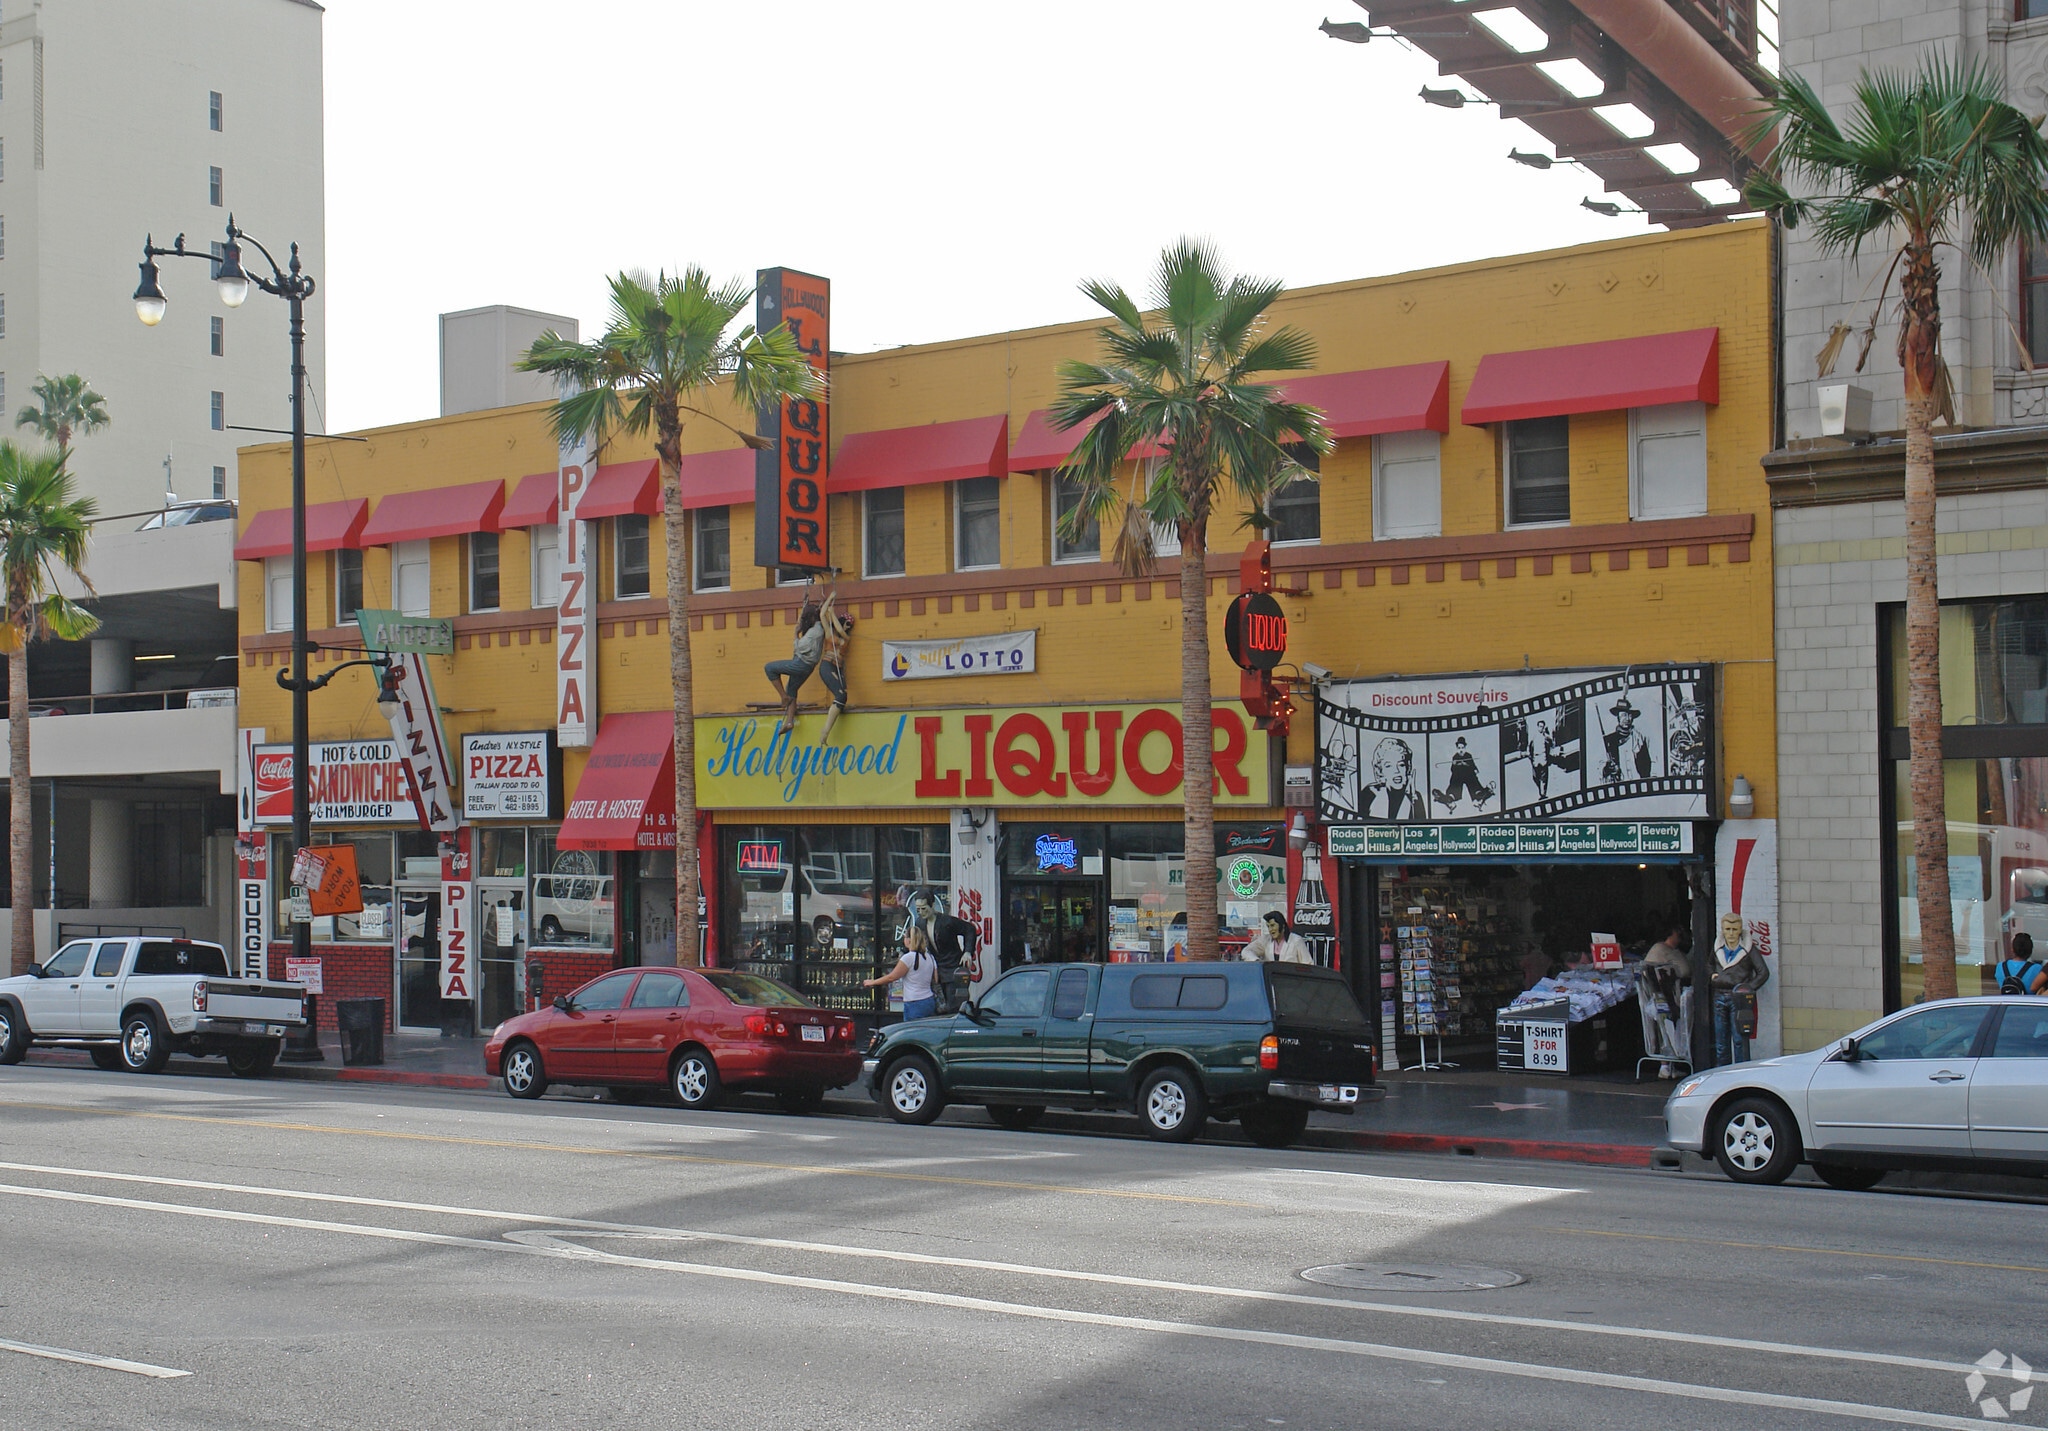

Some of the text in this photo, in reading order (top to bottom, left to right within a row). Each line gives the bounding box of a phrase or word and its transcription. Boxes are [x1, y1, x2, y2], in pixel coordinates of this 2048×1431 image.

[785, 316, 823, 556] LQUOR
[559, 464, 585, 724] PIZZA
[1247, 613, 1289, 652] LIQUOR
[918, 640, 965, 668] Super
[945, 648, 1024, 671] LOTTO
[1371, 689, 1509, 708] Discount Souvenirs
[387, 664, 448, 826] PIZZA
[469, 740, 502, 751] Andre's
[520, 740, 542, 749] STYLE
[321, 744, 392, 763] HOT & COLD
[707, 707, 1250, 803] Hollywood LIQUOR
[259, 756, 294, 781] Coca-Col
[469, 753, 545, 779] PIZZA
[308, 761, 413, 804] SANDWICHE
[474, 782, 500, 790] ITALIAN
[501, 781, 519, 789] FOOD
[520, 781, 529, 789] TO
[468, 795, 485, 803] FREE
[317, 804, 393, 819] & HAMBURGER
[468, 803, 497, 811] DELIVERY
[566, 800, 645, 819] HOTEL & HOSTEL
[644, 813, 654, 826] H
[658, 813, 668, 826] &
[1332, 828, 1364, 839] Rodeo
[1367, 828, 1400, 840] Beverly
[1404, 827, 1424, 838] Los
[1480, 827, 1515, 837] Rodeo
[1519, 826, 1555, 838] Beverly
[1559, 826, 1580, 836] Los
[1642, 825, 1679, 837] Beverly
[637, 832, 656, 846] HOTEL
[1405, 840, 1439, 851] Angeles
[1442, 840, 1476, 851] Hollywood
[1560, 839, 1596, 850] Angeles
[1600, 838, 1638, 850] Hollywood
[1642, 840, 1669, 850] Hills
[1035, 839, 1078, 857] SAMUEL
[1332, 843, 1355, 853] Drive
[1368, 843, 1391, 852] Hills
[1481, 842, 1505, 851] Drive
[1519, 841, 1545, 851] Hills
[557, 853, 575, 871] NEW
[739, 844, 779, 869] ATM
[962, 850, 983, 871] 7040
[1037, 853, 1076, 870] ADAMS
[1230, 861, 1259, 881] Heineken
[323, 865, 345, 897] WORK
[553, 877, 594, 890] PIZZA
[334, 878, 355, 907] ROAD
[1236, 884, 1255, 895] Beer
[1230, 906, 1240, 920] A
[445, 885, 468, 997] PIZZA
[288, 968, 298, 978] NO
[1526, 1026, 1564, 1039] T-SHIRT
[1533, 1039, 1557, 1051] 3 FOR
[1532, 1053, 1558, 1066] 8.99
